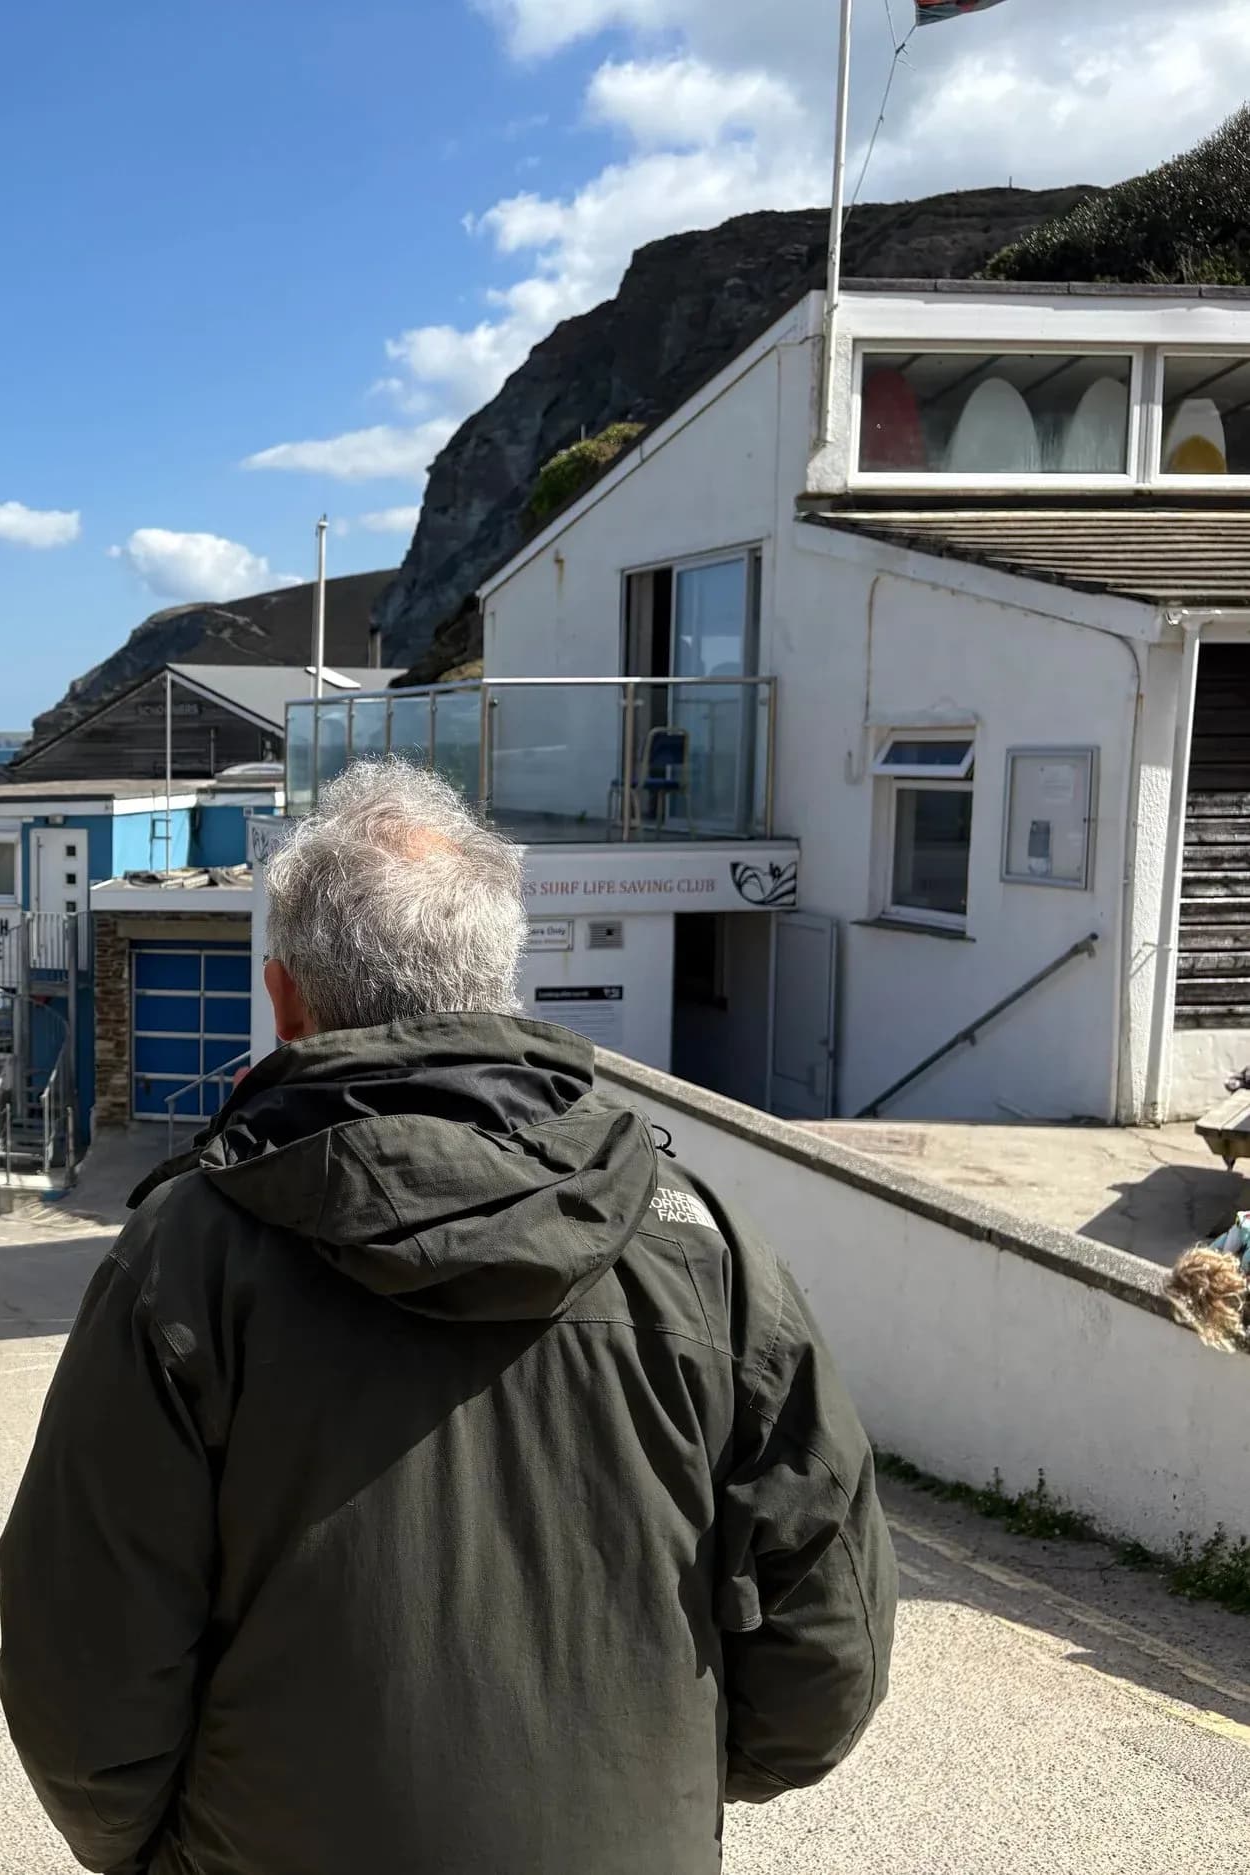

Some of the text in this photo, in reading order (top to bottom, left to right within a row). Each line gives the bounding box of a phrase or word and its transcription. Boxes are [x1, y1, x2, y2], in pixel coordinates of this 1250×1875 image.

[541, 880, 579, 896] SURF
[583, 880, 615, 895] LIFE
[619, 879, 673, 894] SAVING
[676, 878, 716, 893] CLUB
[656, 1187, 687, 1201] THE
[649, 1197, 692, 1213] ORTH
[657, 1208, 697, 1224] FACE
